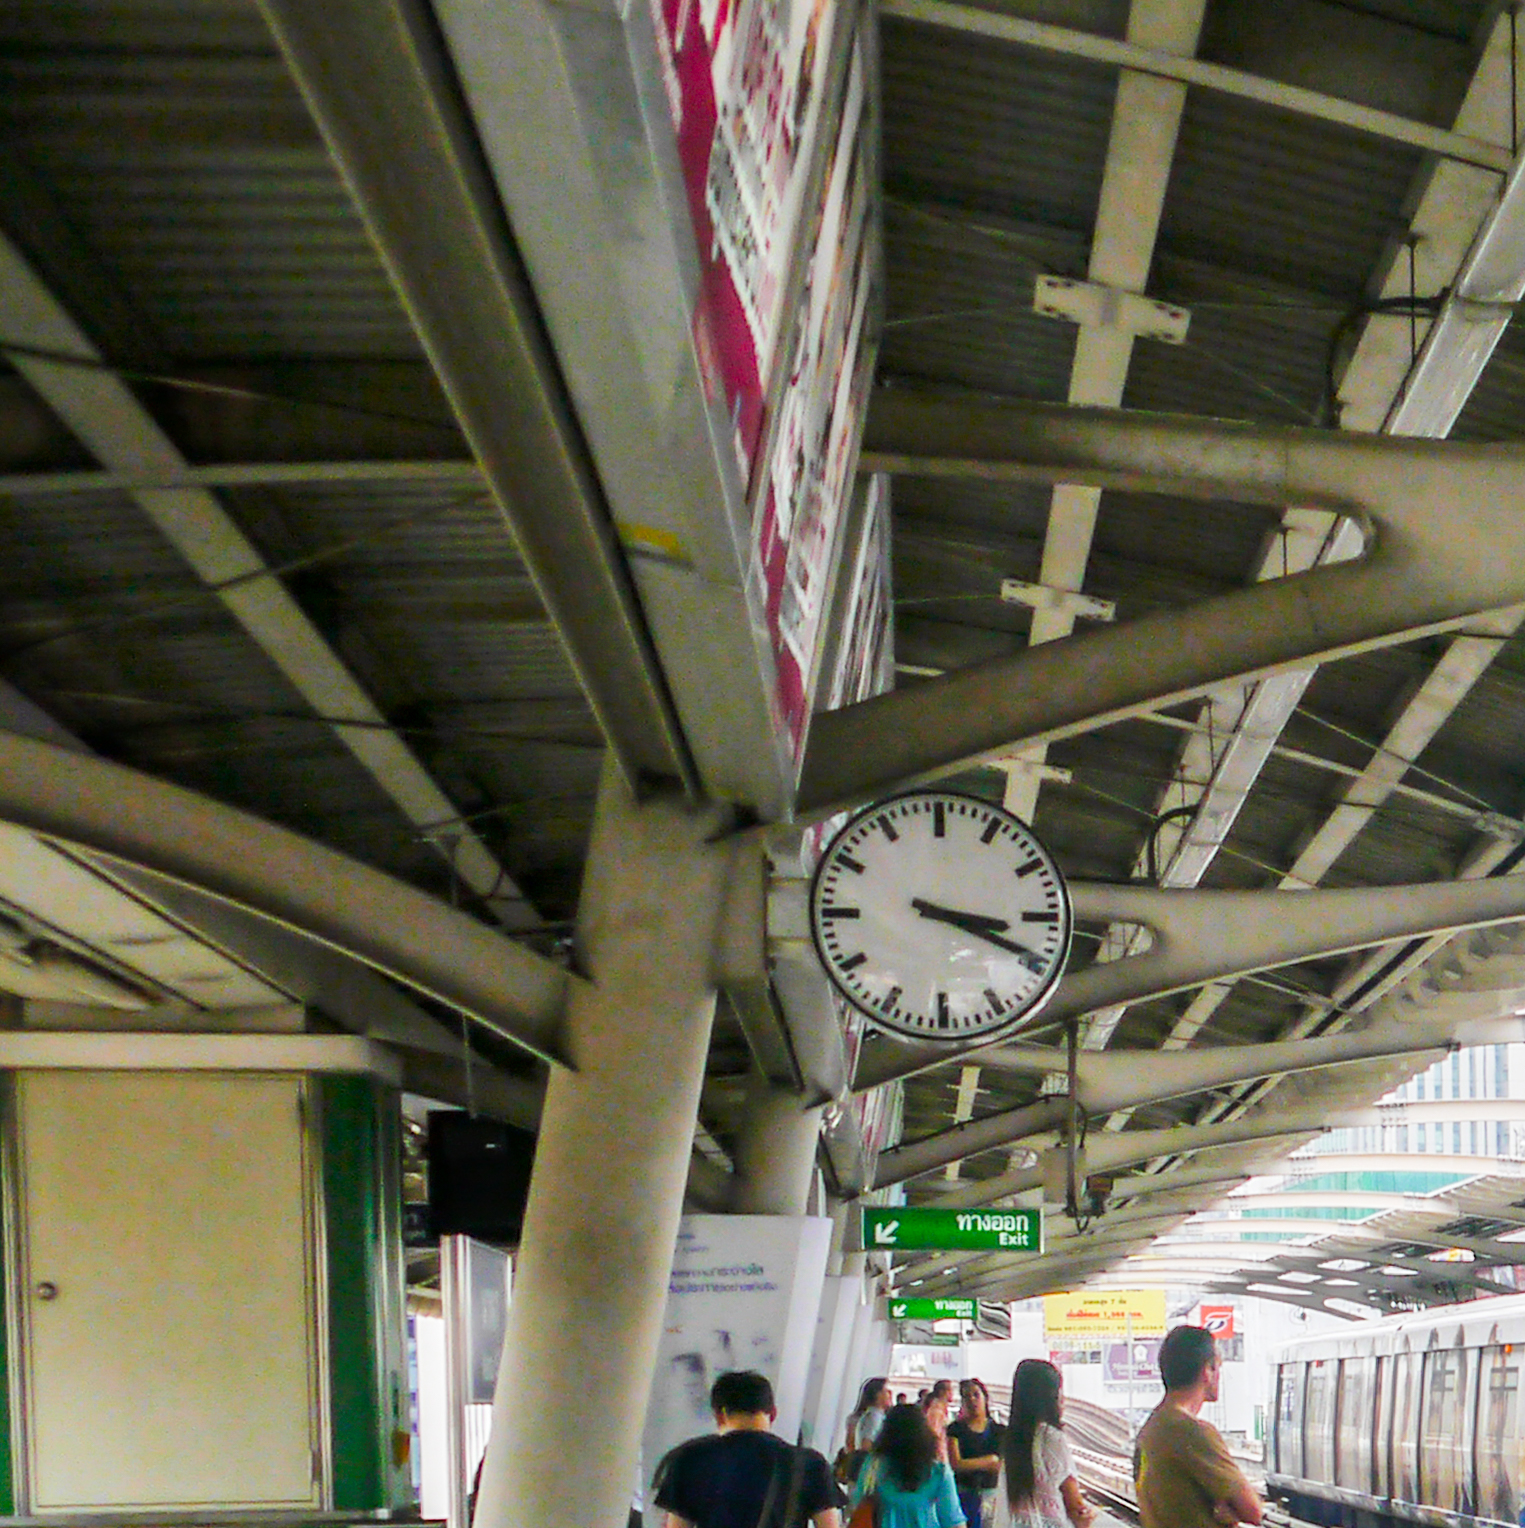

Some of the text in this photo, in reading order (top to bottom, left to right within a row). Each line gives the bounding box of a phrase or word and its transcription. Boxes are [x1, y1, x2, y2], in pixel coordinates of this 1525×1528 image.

[956, 1213, 1029, 1232] ทางออก
[999, 1232, 1029, 1247] Exit
